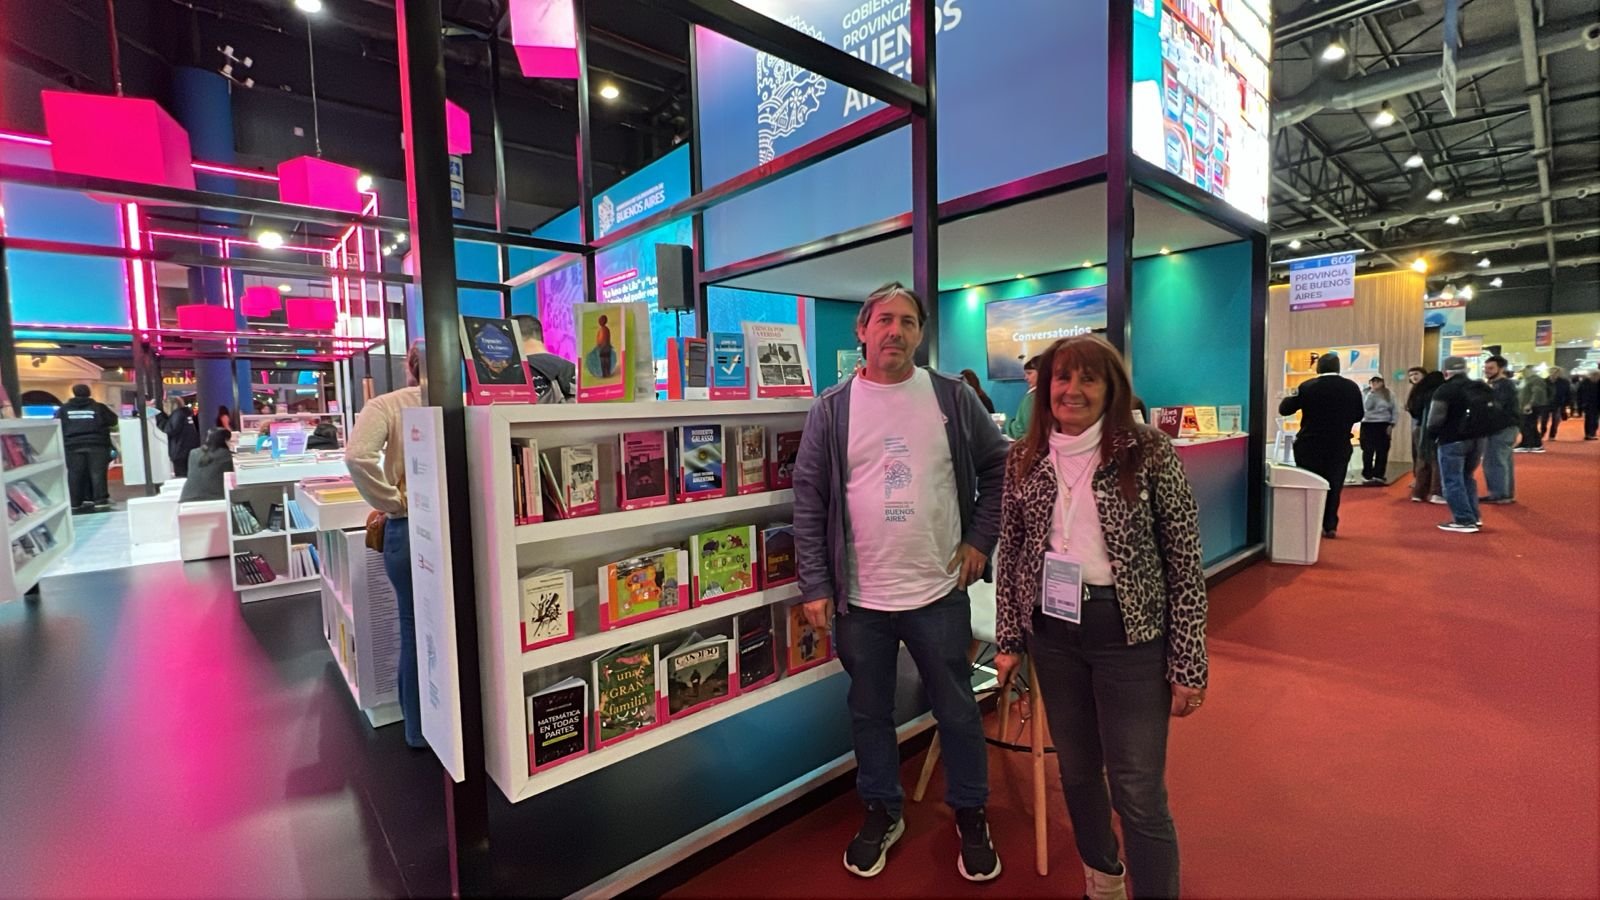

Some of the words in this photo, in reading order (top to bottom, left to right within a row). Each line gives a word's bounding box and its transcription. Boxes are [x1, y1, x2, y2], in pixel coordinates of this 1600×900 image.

[616, 201, 644, 223] BUENOS
[644, 190, 666, 211] AIRES
[1331, 254, 1353, 265] 602
[1295, 268, 1348, 281] PROVINCIA
[1295, 283, 1309, 291] DE
[1310, 278, 1351, 289] BUENOS
[1295, 291, 1323, 300] AIRES
[1012, 325, 1092, 342] Conversatorios
[691, 435, 714, 443] GALASSO
[885, 508, 915, 516] BUENOS
[609, 680, 645, 699] GRAN
[608, 692, 648, 716] familia
[538, 709, 580, 727] MATEMÁTICA
[540, 726, 551, 734] EN
[553, 717, 580, 730] TODAS
[545, 724, 575, 739] PARTES
